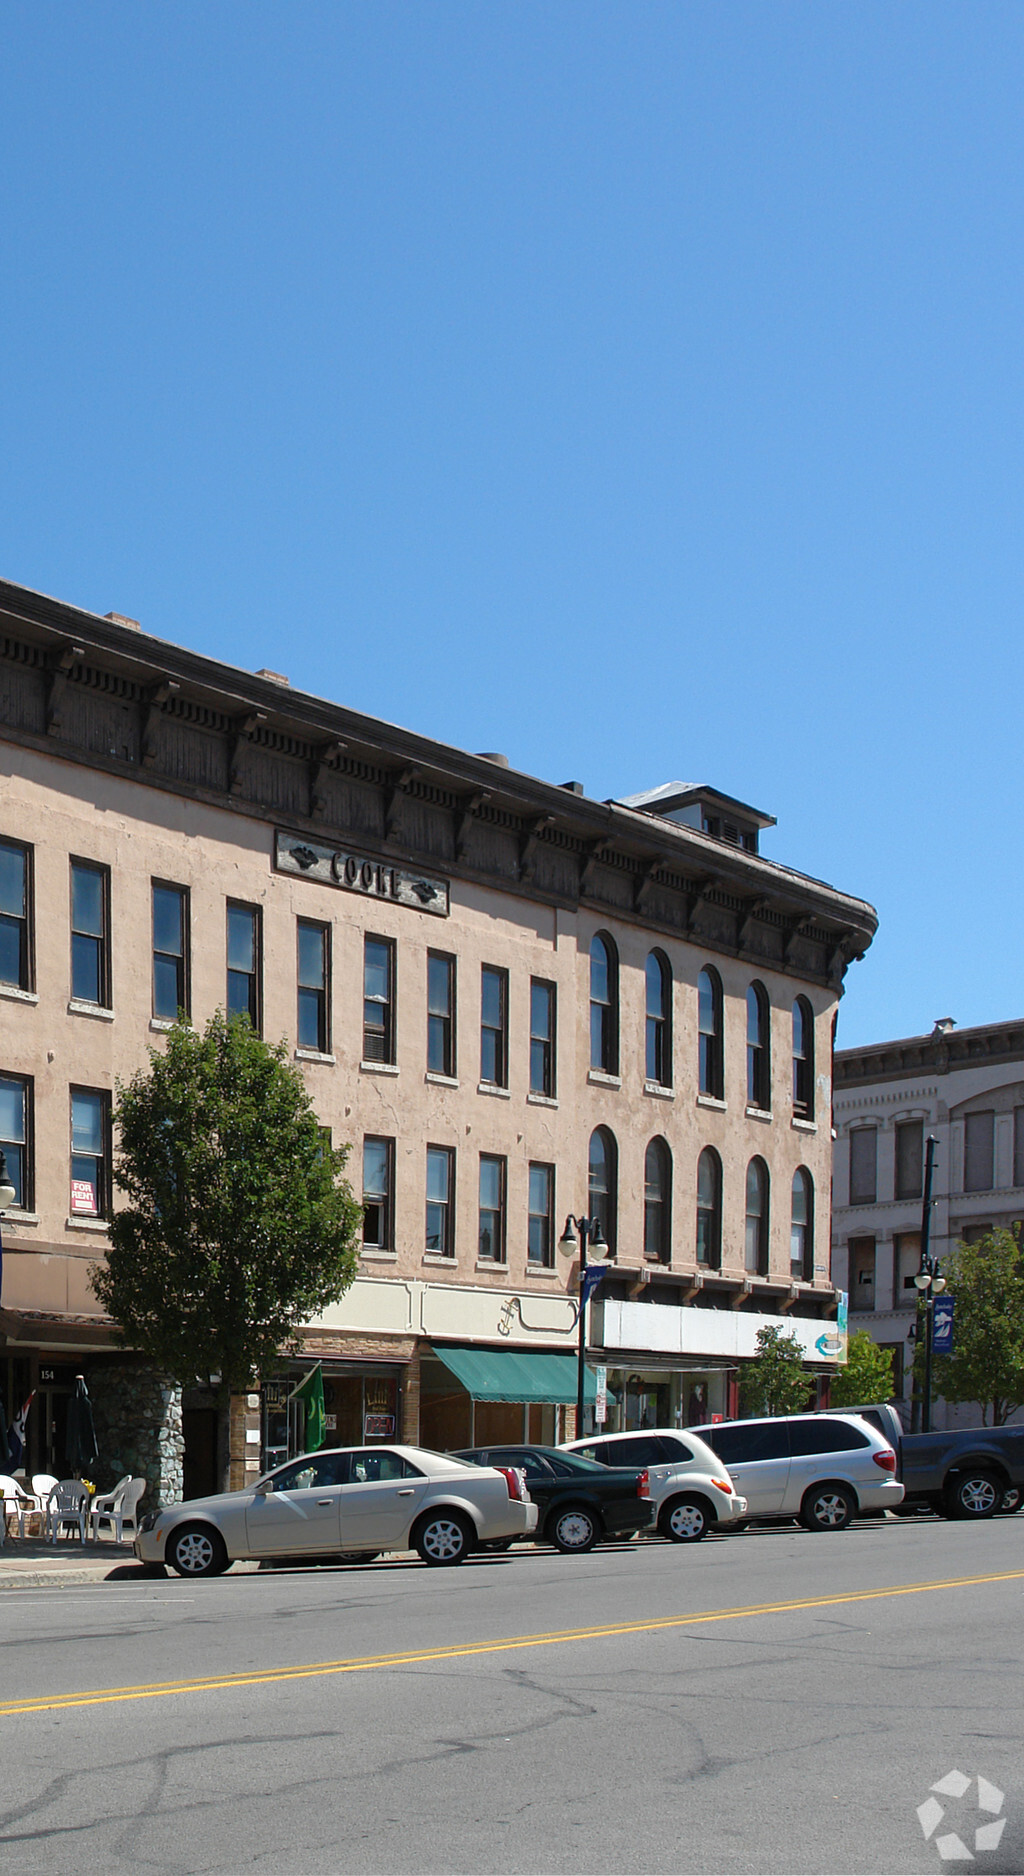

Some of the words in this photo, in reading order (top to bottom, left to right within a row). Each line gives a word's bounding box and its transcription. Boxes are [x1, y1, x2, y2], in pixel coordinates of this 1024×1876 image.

[330, 852, 401, 899] COOKE
[73, 1183, 92, 1192] FOR
[72, 1191, 94, 1201] RENT
[41, 1370, 54, 1380] 154
[366, 1417, 393, 1434] OPEN
